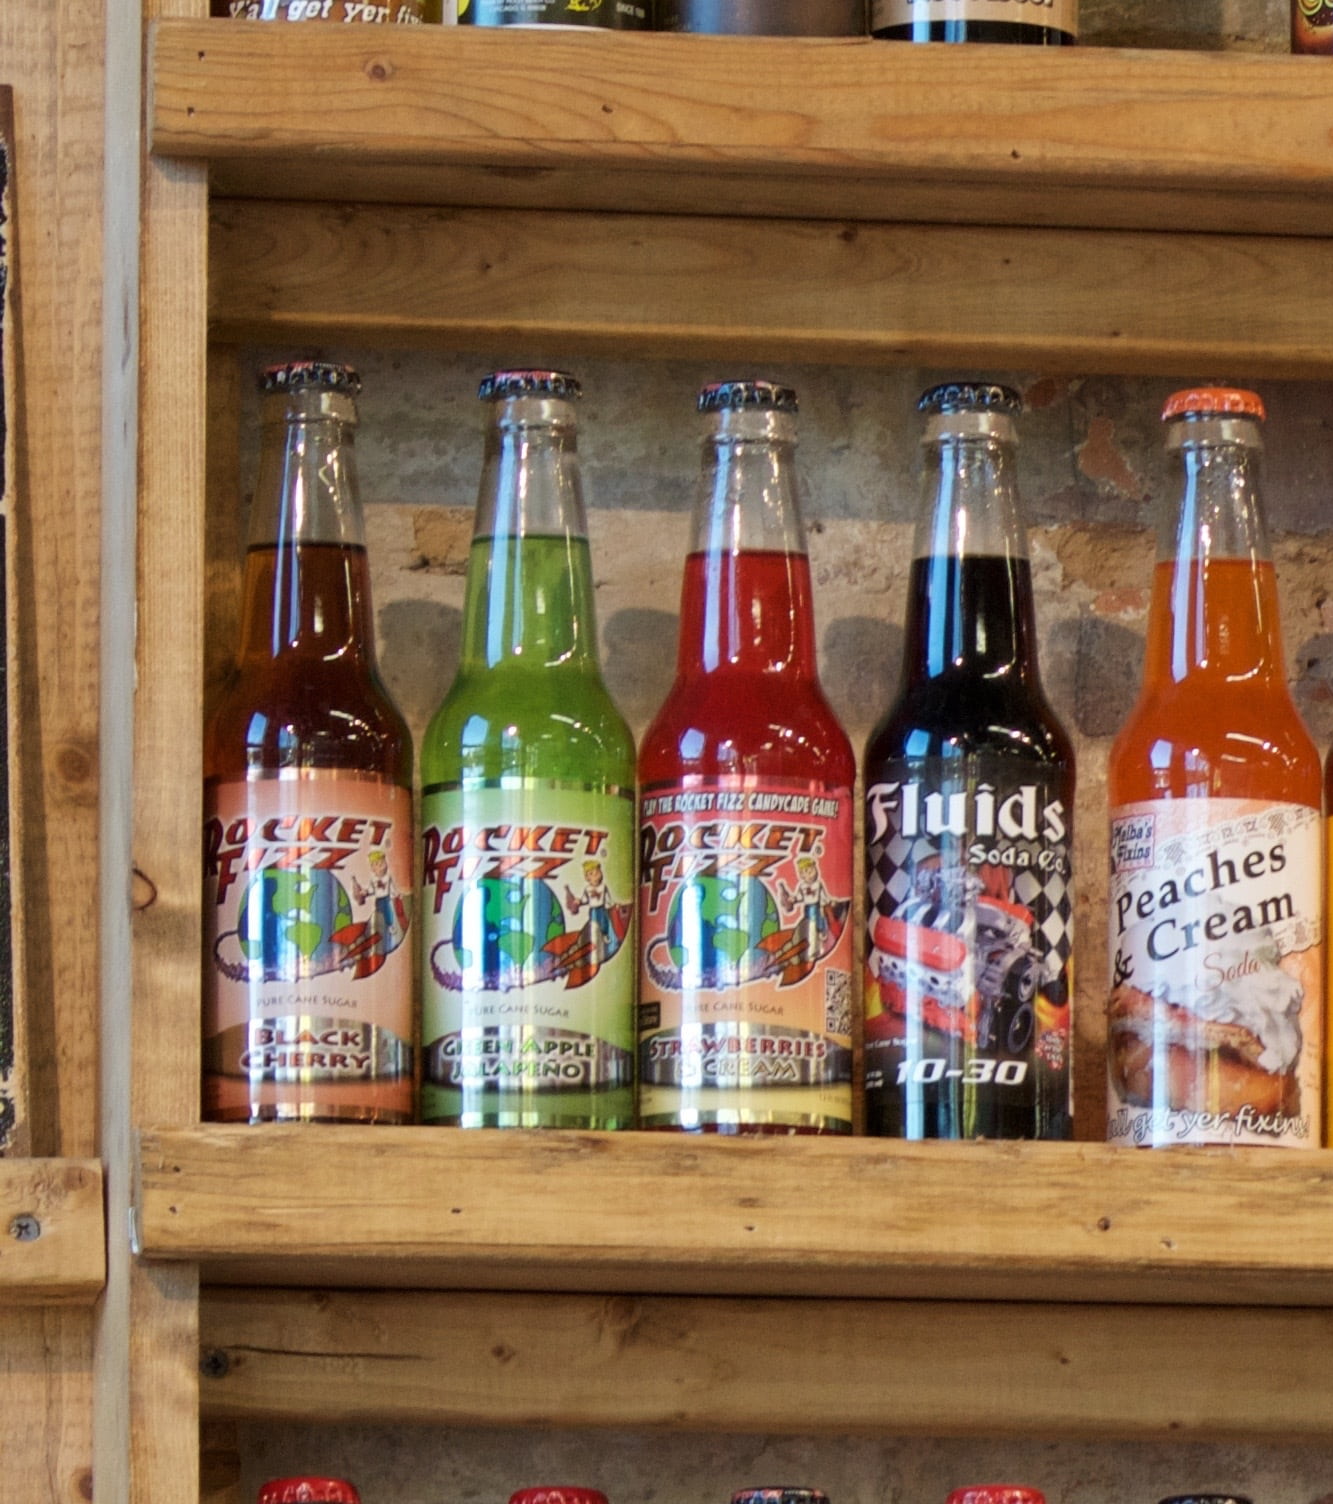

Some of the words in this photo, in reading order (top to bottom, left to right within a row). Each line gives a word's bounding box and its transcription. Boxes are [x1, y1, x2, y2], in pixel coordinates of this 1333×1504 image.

[1113, 842, 1288, 932] Peaches
[1146, 889, 1294, 965] Cream
[895, 1058, 1027, 1086] 10-30
